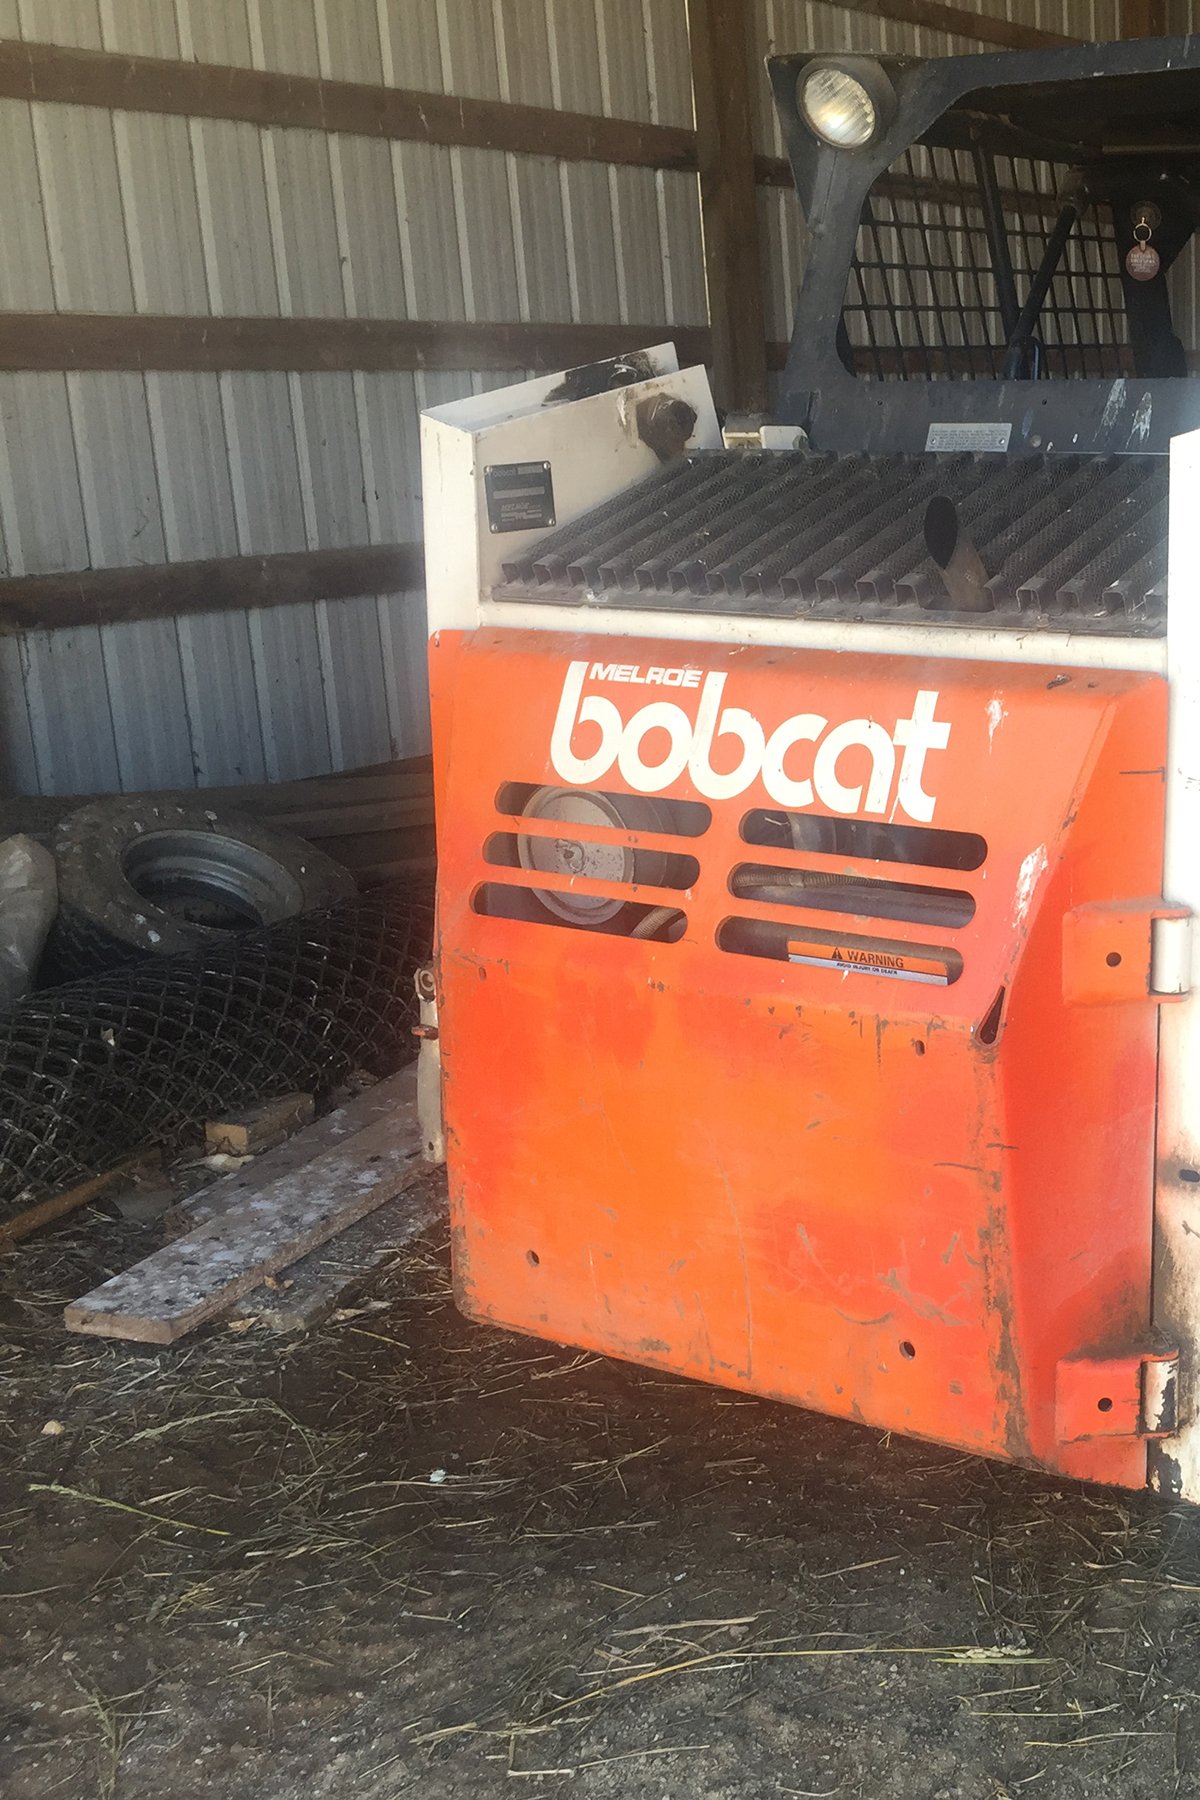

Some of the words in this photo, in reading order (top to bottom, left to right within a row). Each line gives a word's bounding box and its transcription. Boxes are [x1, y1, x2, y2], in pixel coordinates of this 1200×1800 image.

[589, 662, 703, 688] MELROE
[550, 660, 951, 823] bobcat
[847, 950, 904, 968] WARNING
